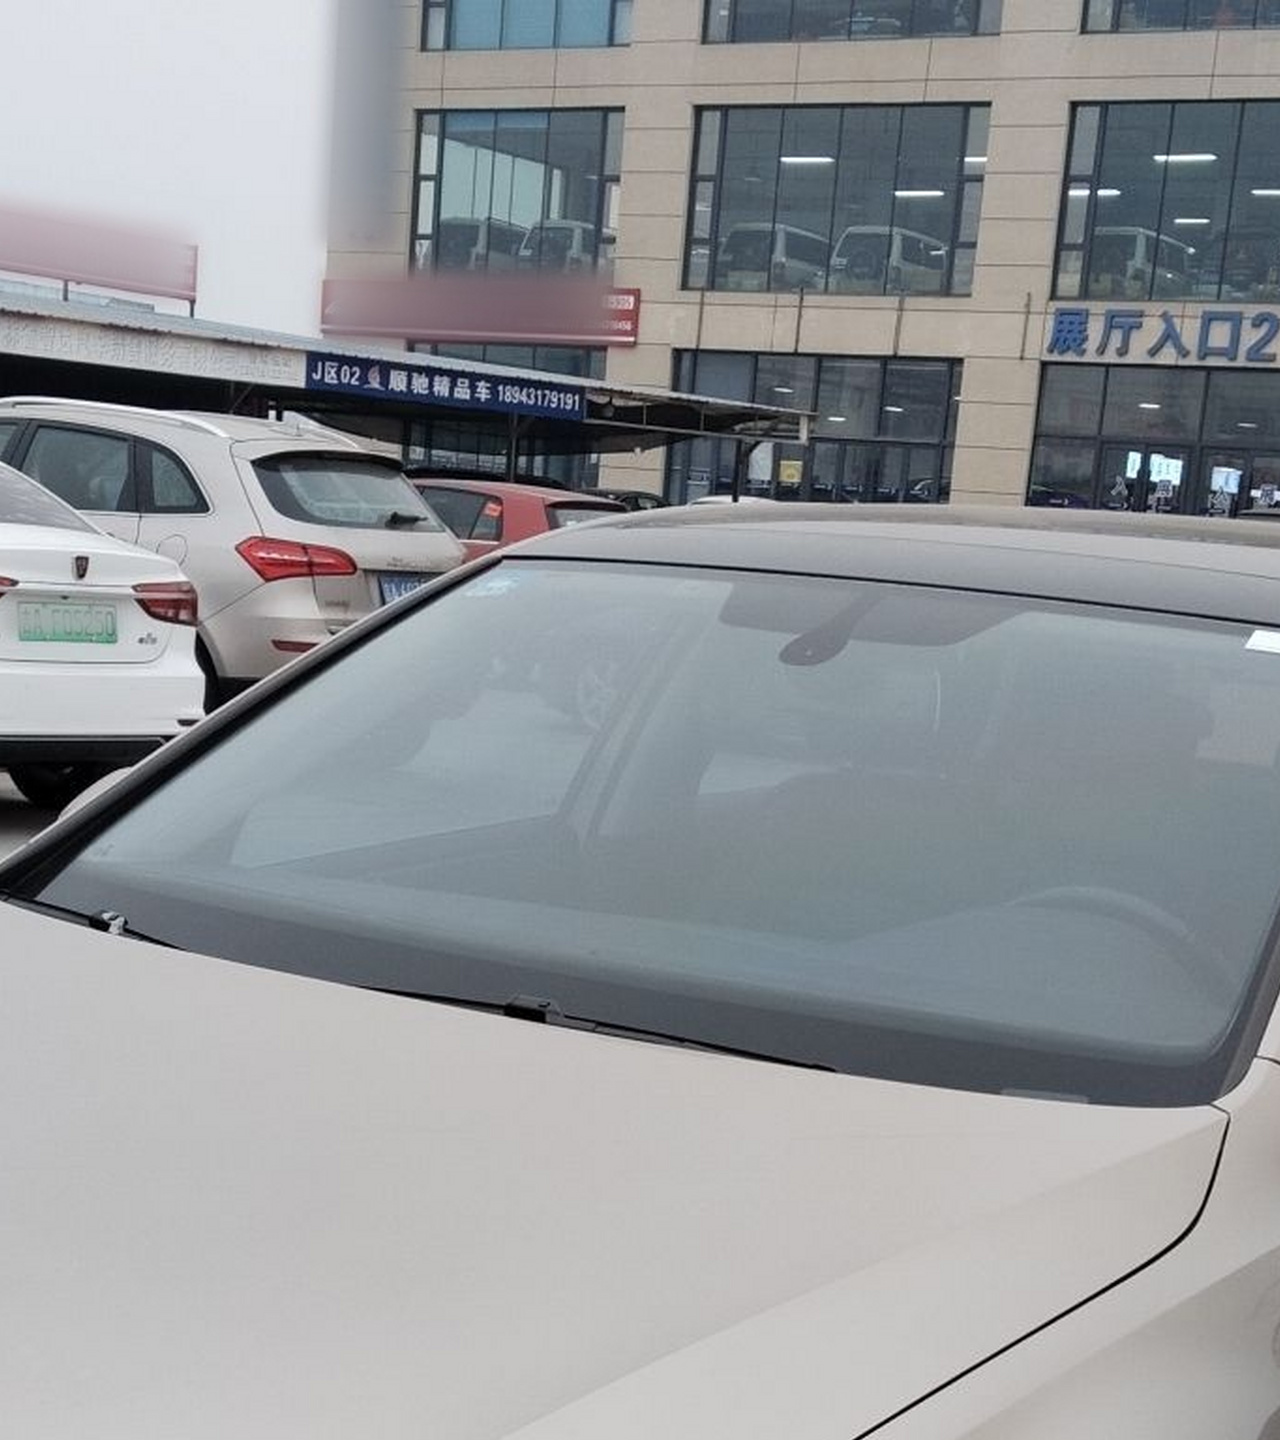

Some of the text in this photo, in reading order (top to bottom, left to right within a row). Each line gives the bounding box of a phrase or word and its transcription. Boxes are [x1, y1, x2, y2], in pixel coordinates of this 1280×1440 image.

[311, 360, 581, 411] J区02 顺驰精品车 18943179191
